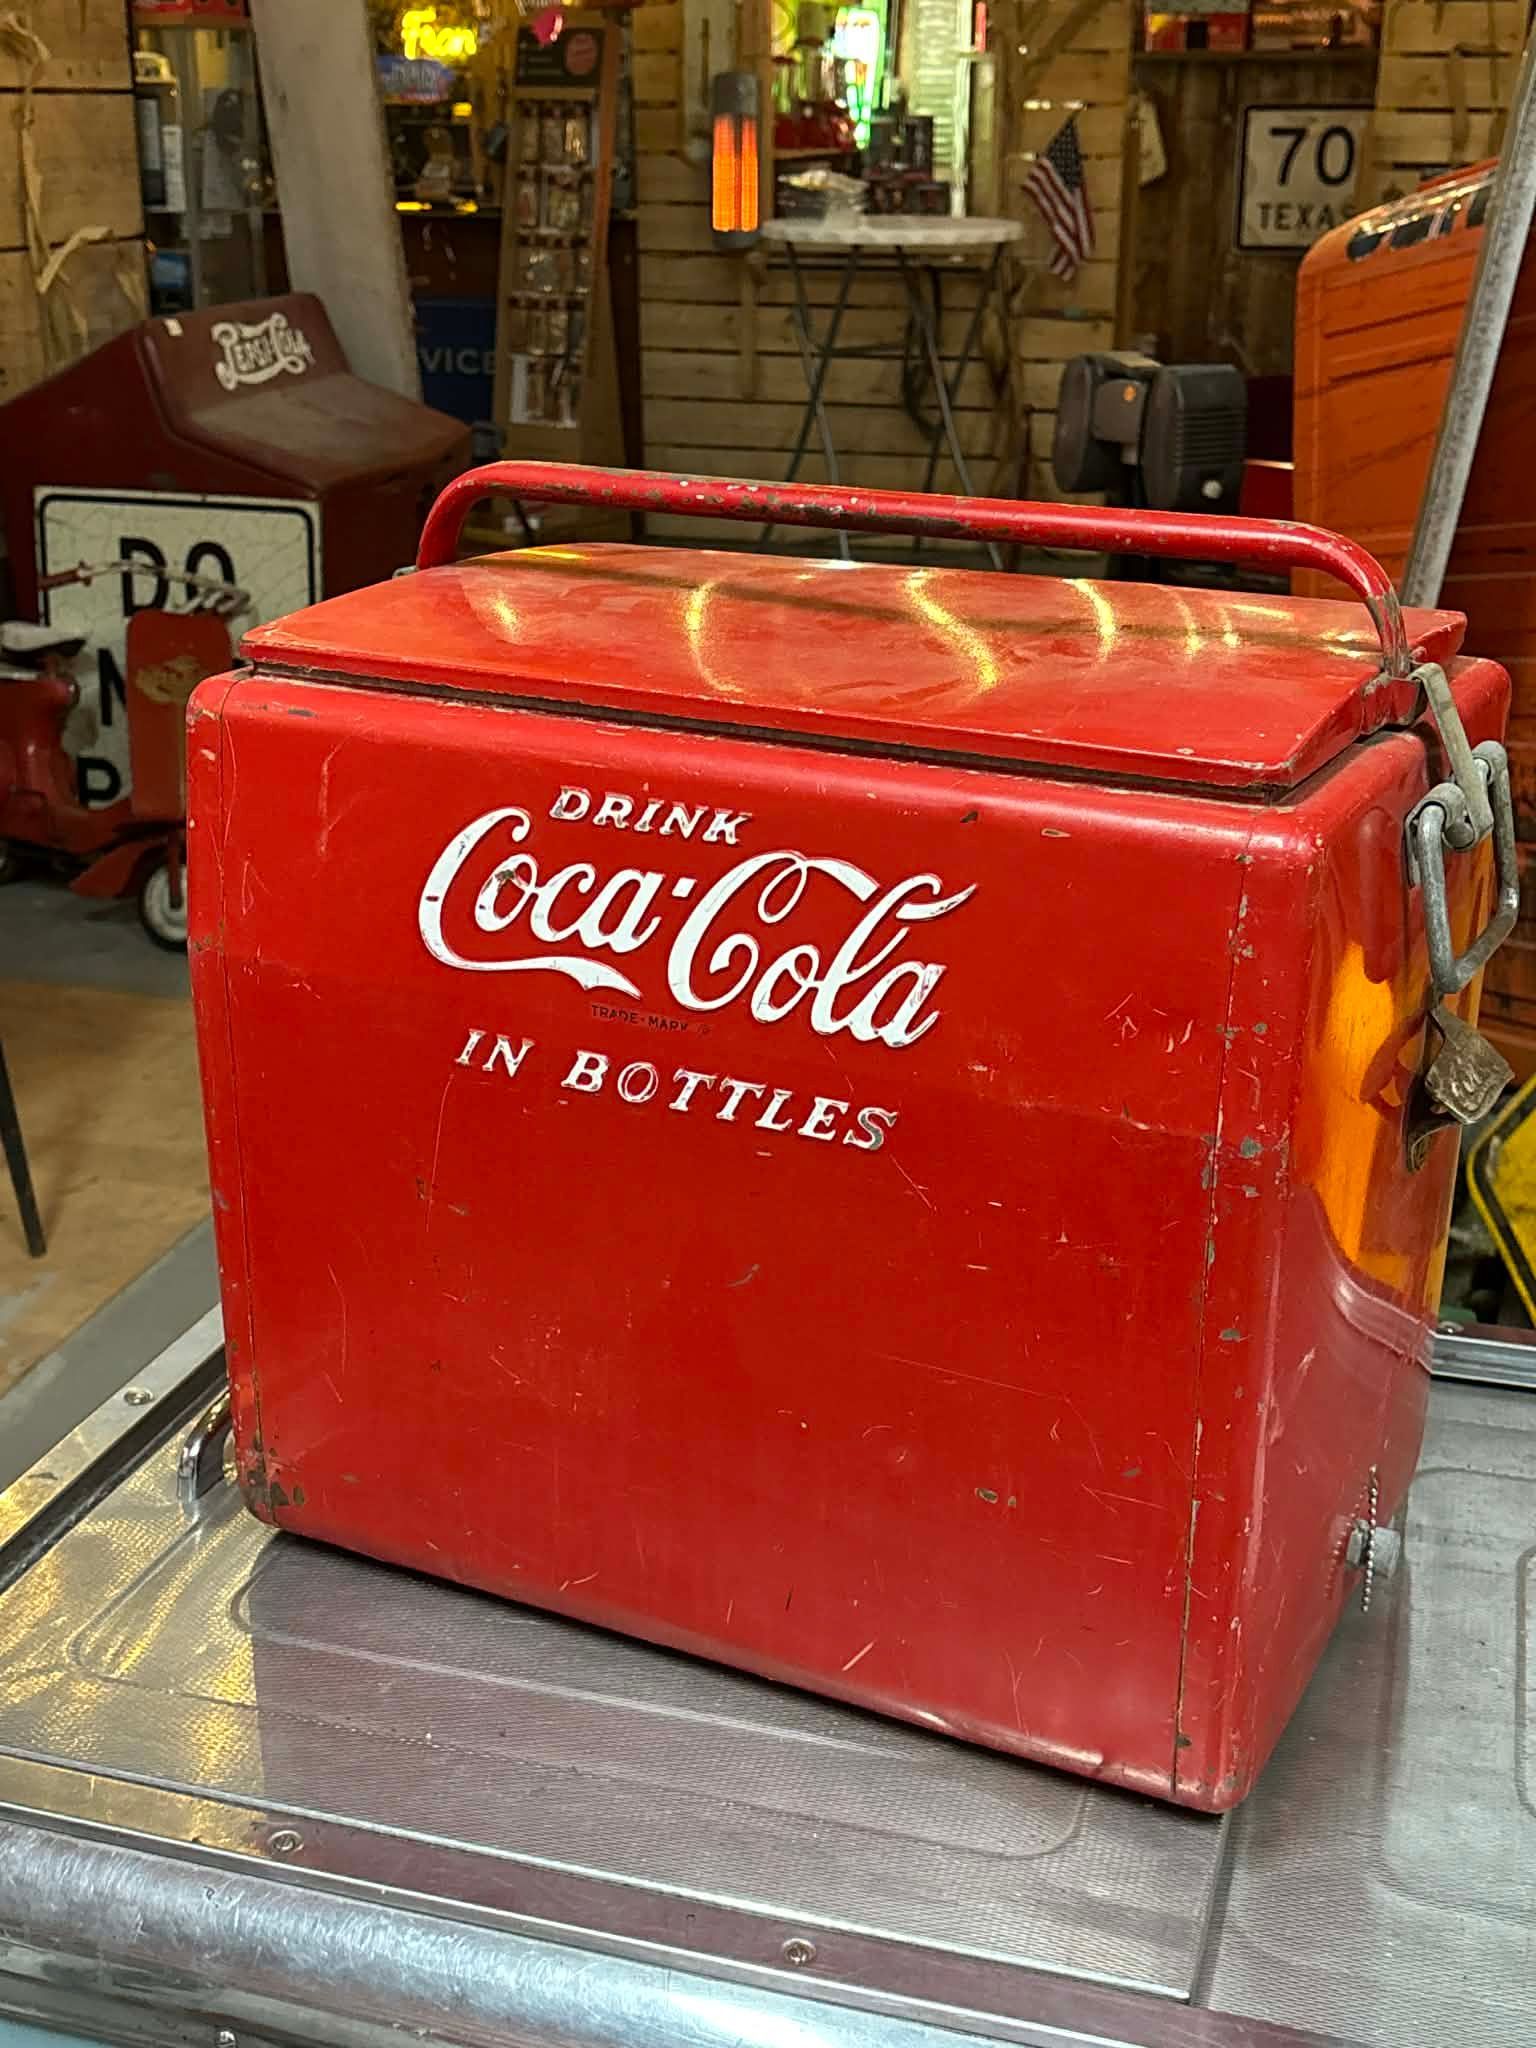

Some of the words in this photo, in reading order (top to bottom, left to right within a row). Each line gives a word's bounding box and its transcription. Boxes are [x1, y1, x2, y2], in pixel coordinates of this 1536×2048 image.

[1269, 125, 1354, 187] 70
[120, 536, 236, 617] DO
[550, 785, 752, 845] DRINK
[418, 806, 978, 1048] Coca-Cola
[454, 1028, 536, 1078] IN
[560, 1049, 898, 1150] BOTTLES
